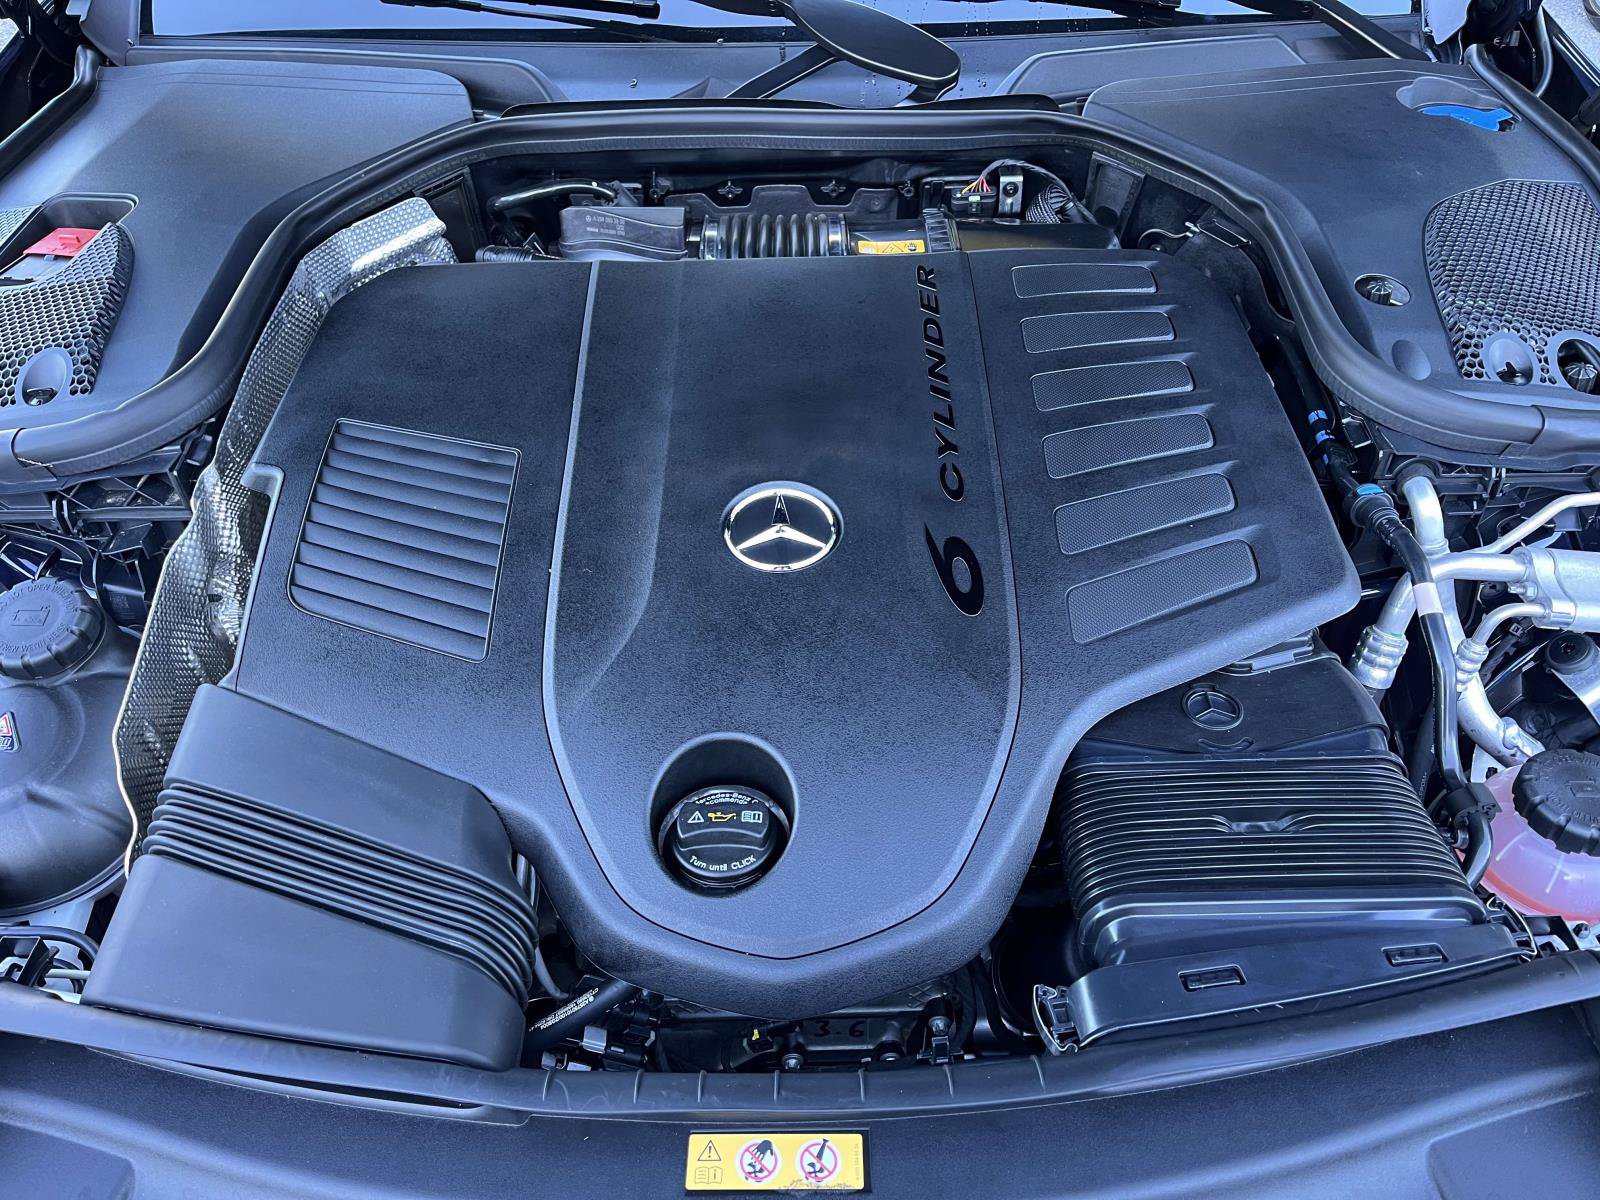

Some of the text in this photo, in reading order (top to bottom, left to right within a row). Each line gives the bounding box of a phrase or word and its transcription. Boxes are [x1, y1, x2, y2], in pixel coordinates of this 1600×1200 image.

[916, 264, 984, 617] 6 CYLINDER
[689, 854, 757, 871] Turn until CLICK
